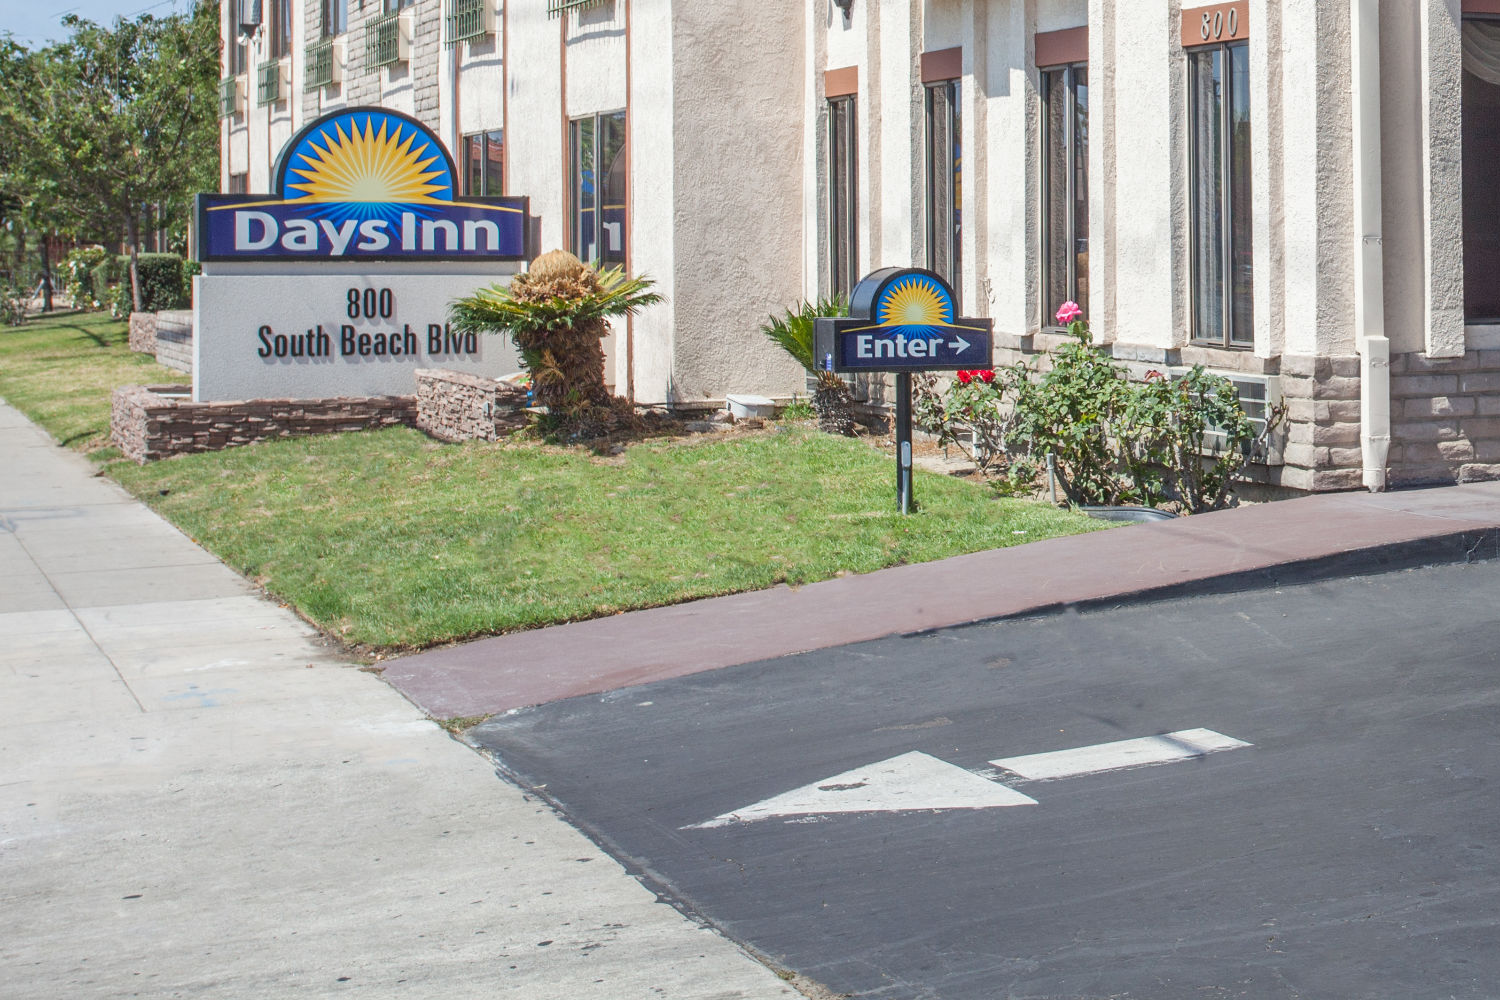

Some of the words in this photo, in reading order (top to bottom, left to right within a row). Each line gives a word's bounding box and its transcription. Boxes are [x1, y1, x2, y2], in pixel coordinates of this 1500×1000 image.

[1201, 7, 1238, 40] 800
[235, 211, 390, 256] Days
[402, 212, 500, 251] Inn
[347, 287, 393, 319] 800
[258, 325, 331, 358] South
[341, 324, 417, 357] Beach
[857, 333, 944, 359] Enter
